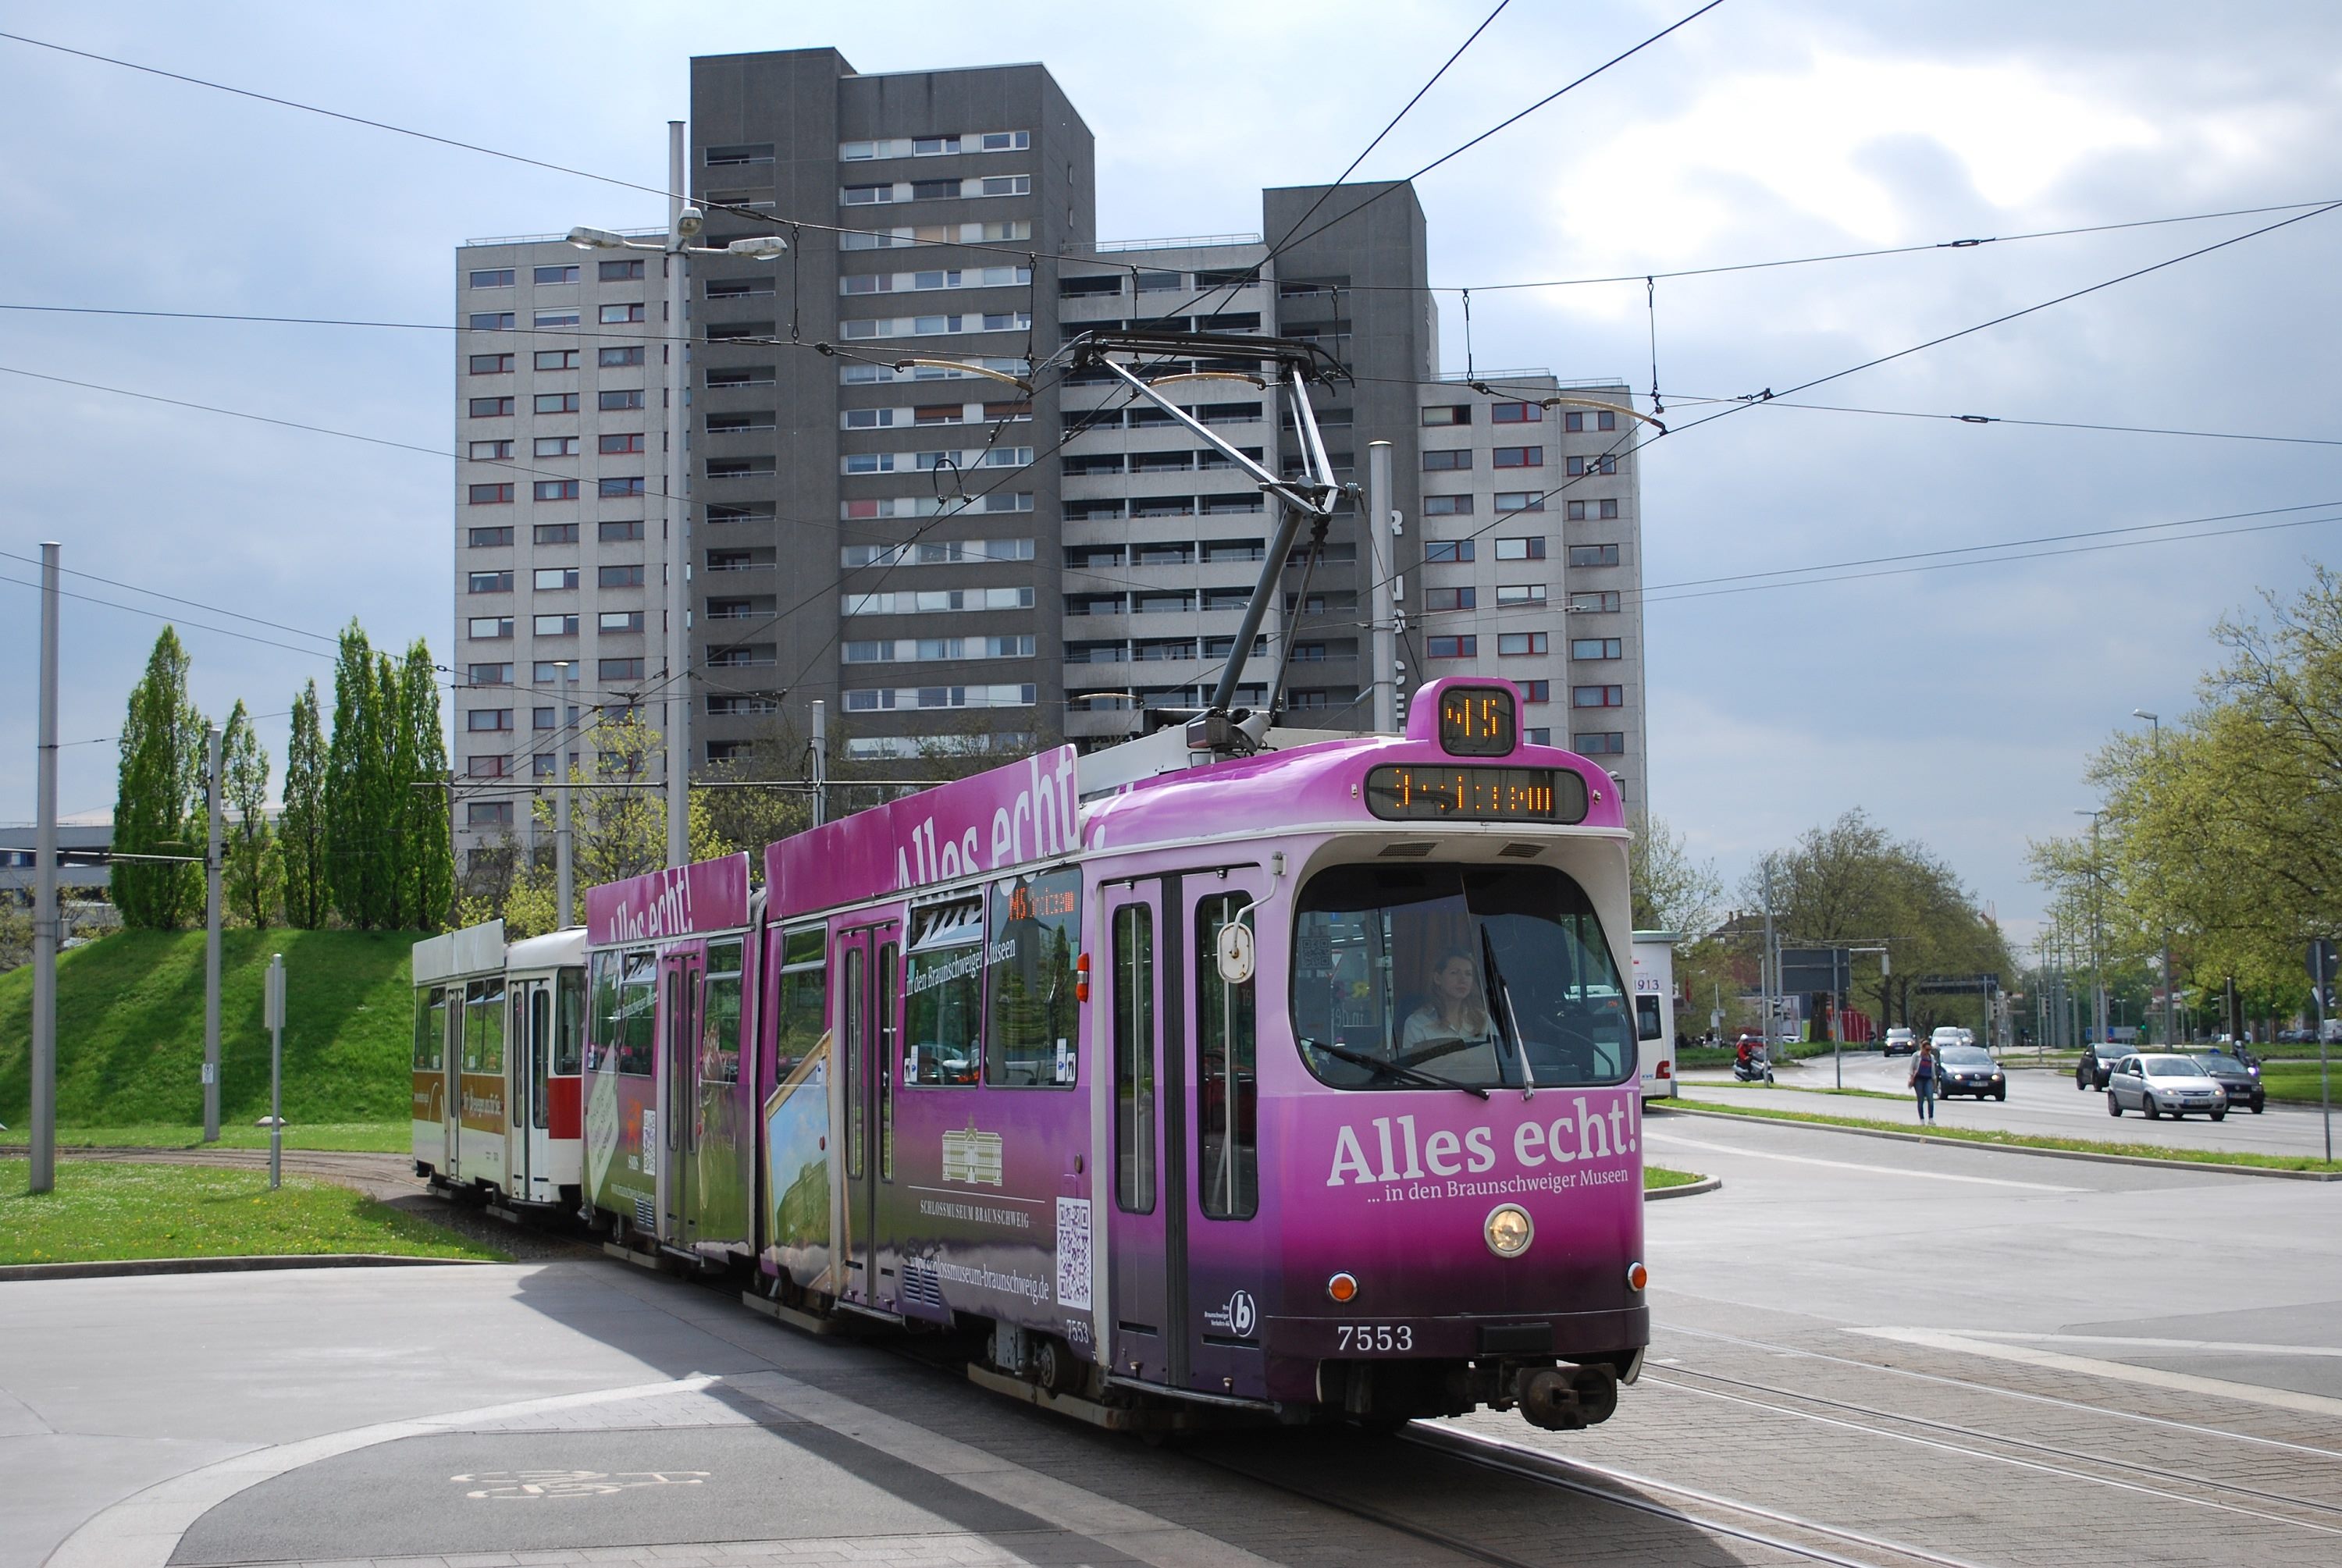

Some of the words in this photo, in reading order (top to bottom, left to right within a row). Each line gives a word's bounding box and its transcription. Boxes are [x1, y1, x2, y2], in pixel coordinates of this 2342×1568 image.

[913, 968, 927, 994] den
[927, 948, 984, 988] Braunschweiger
[984, 937, 1016, 966] Museen
[1326, 1115, 1496, 1186] Alles
[1513, 1092, 1637, 1167] echt!
[1385, 1184, 1404, 1202] in
[1408, 1181, 1442, 1200] den
[1447, 1173, 1576, 1197] Braunschweiger
[1580, 1168, 1628, 1186] Museen
[920, 1200, 973, 1222] SCHLOSSMUSEUM
[974, 1207, 1030, 1228] BRAUNSCHWEIG
[1066, 1319, 1089, 1343] 7553
[1337, 1324, 1413, 1352] 7553
